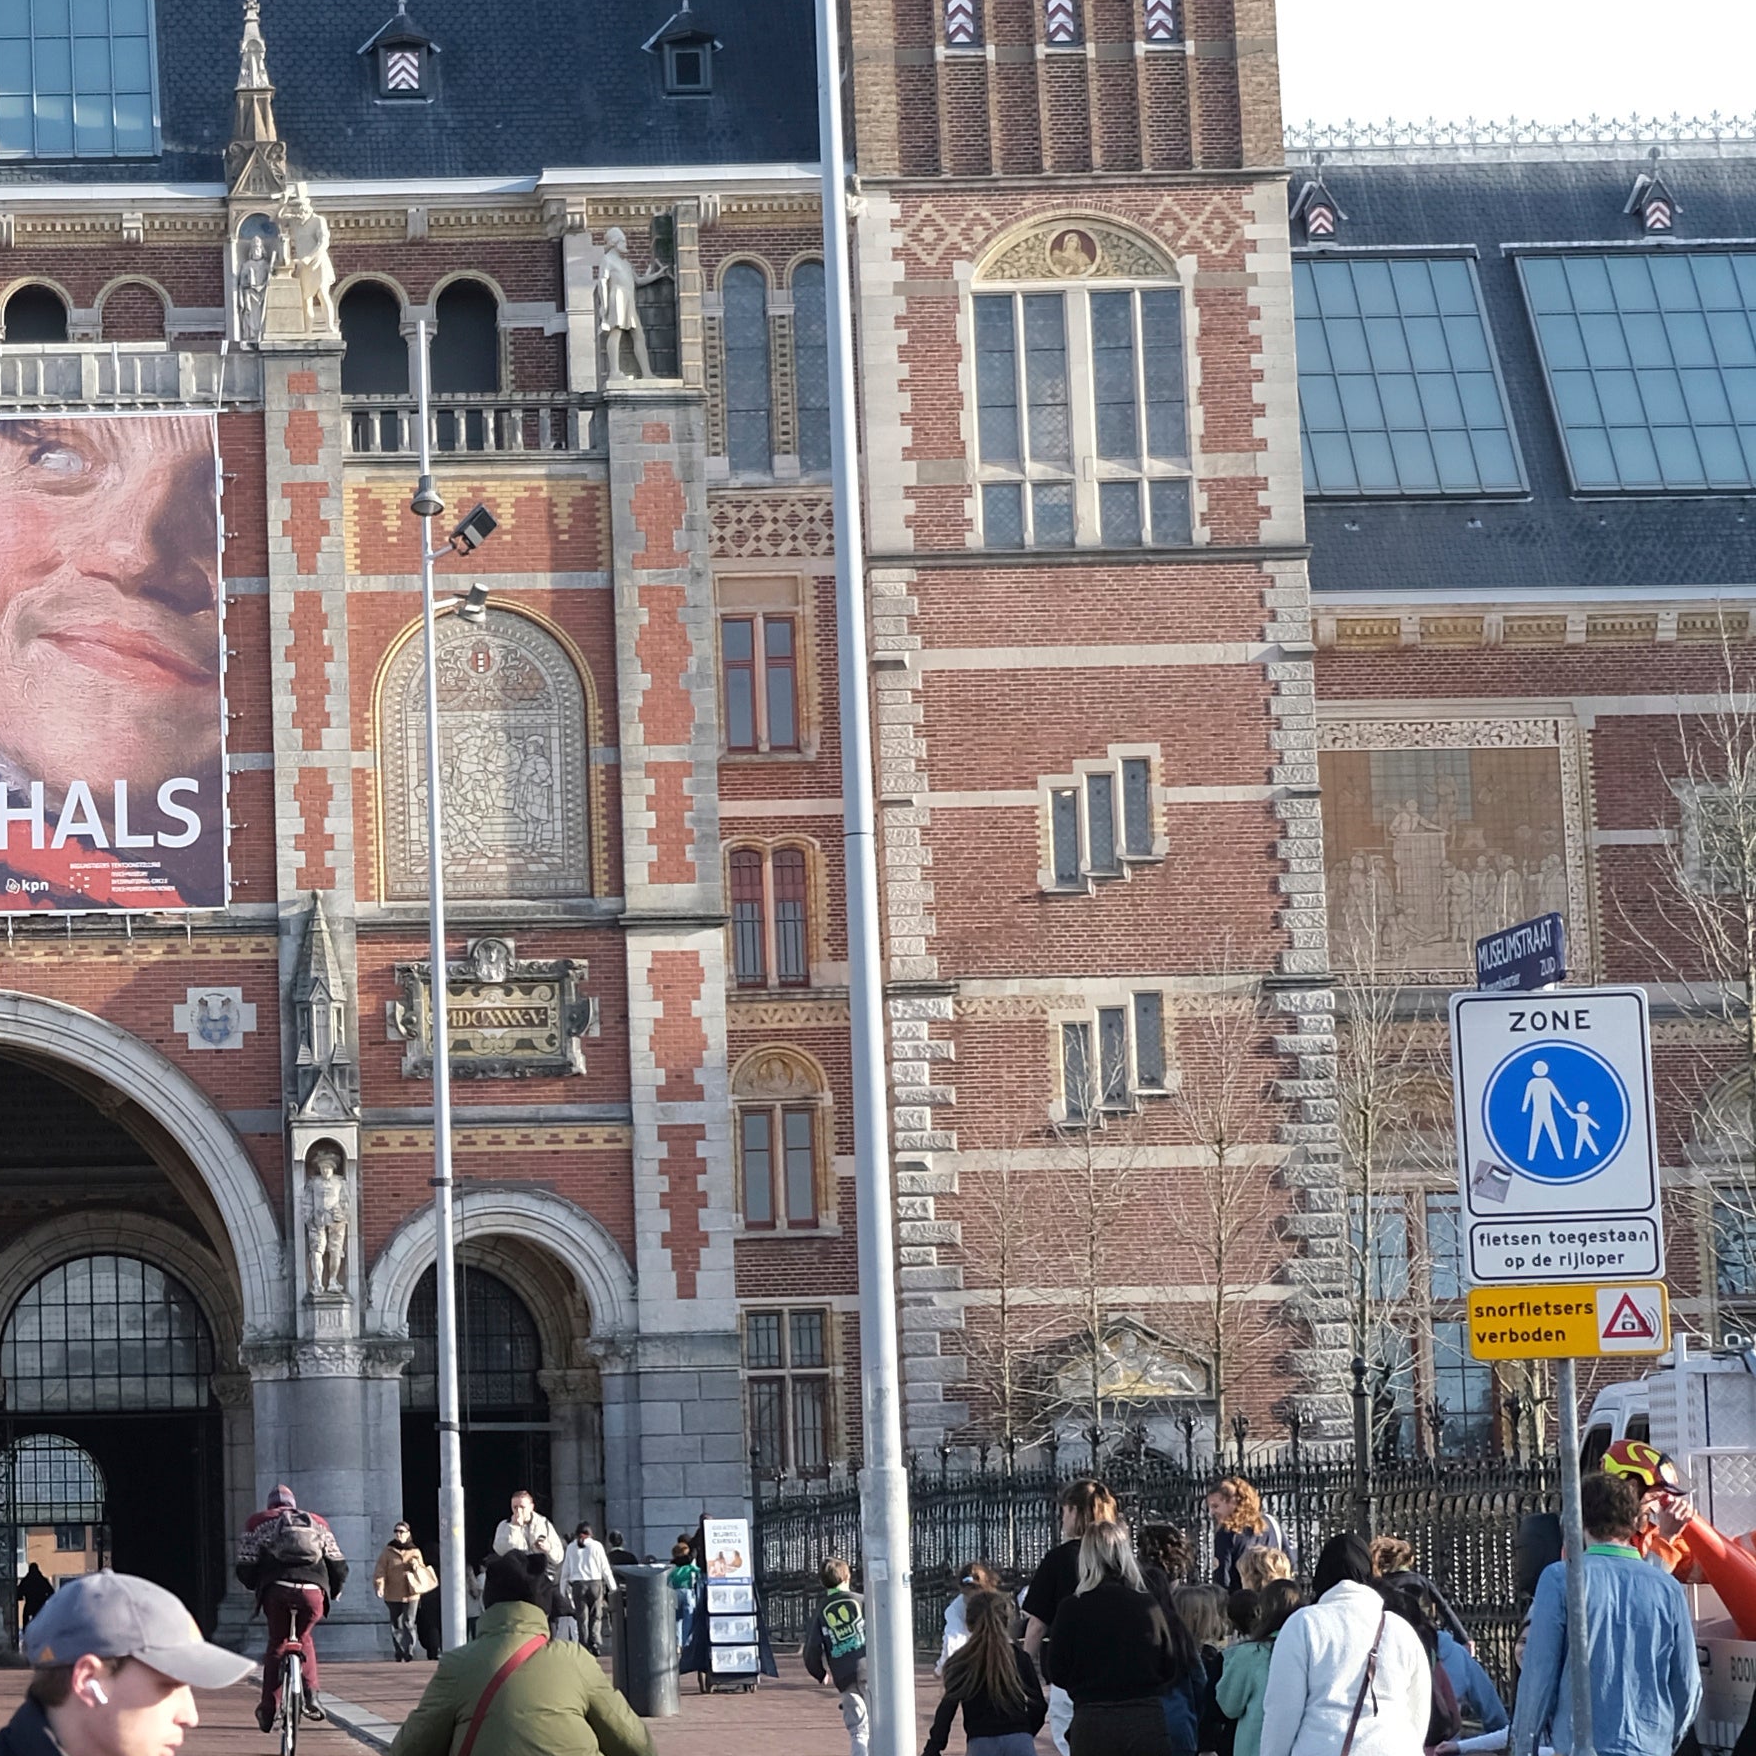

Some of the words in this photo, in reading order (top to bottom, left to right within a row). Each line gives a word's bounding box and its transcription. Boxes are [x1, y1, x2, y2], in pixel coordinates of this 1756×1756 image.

[21, 879, 49, 893] kpn
[1477, 919, 1552, 973] MUSEUMSTRAAT
[1539, 956, 1556, 976] ZUID
[1509, 1009, 1591, 1033] ZONE
[1478, 1233, 1542, 1246] fietsen
[1549, 1229, 1649, 1247] toegestaan
[1505, 1256, 1525, 1270] op
[1532, 1253, 1552, 1267] de
[1559, 1252, 1625, 1270] rijloper
[1474, 1301, 1594, 1318] snorfietsers
[1476, 1327, 1566, 1343] verboden
